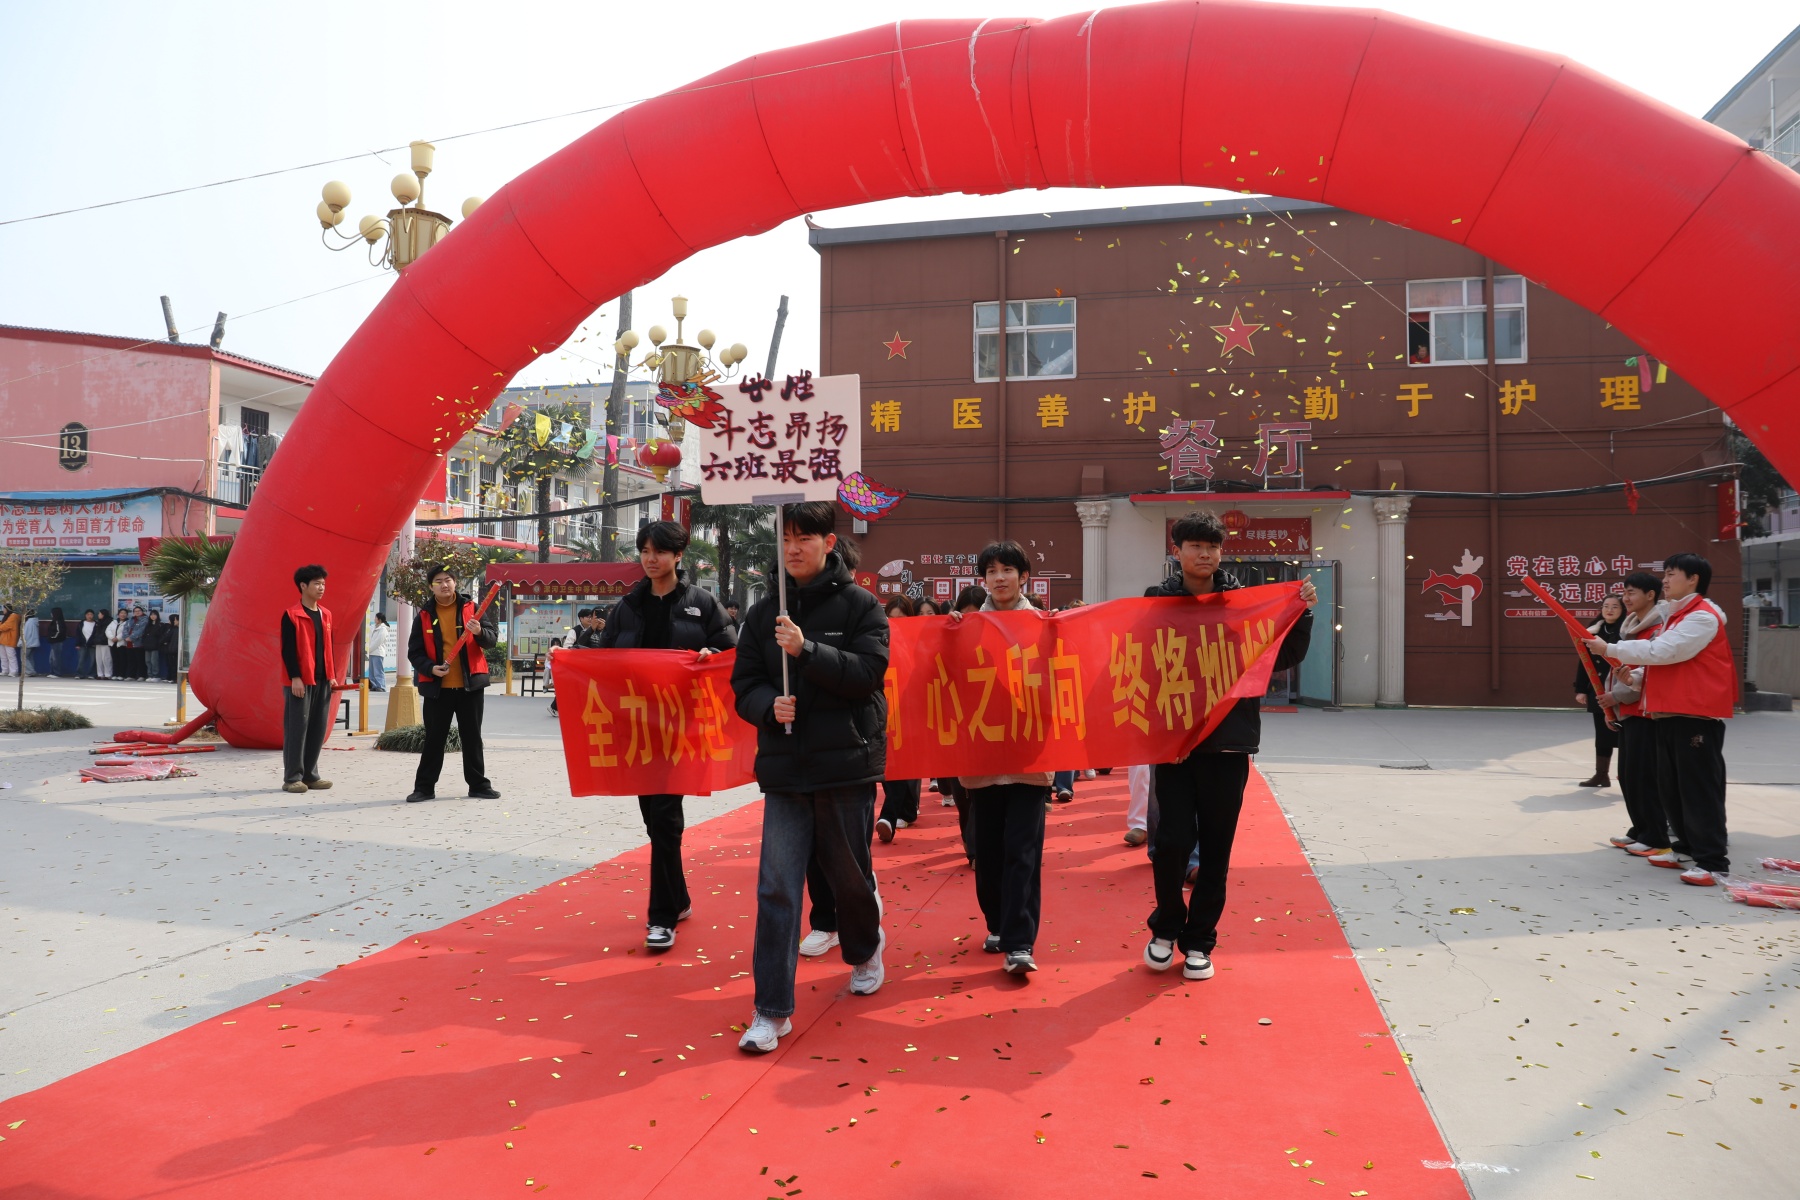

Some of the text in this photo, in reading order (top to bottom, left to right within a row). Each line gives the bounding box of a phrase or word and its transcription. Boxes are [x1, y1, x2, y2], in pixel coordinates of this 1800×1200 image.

[61, 435, 82, 459] 13
[714, 409, 848, 451] 斗志昂扬
[1159, 418, 1312, 479] 餐厅
[701, 447, 844, 484] 六班最强
[62, 516, 145, 534] 为国育才使命
[1506, 555, 1633, 577] 党在我心中
[581, 676, 734, 768] 全力以赴
[926, 638, 1087, 747] 心之所向
